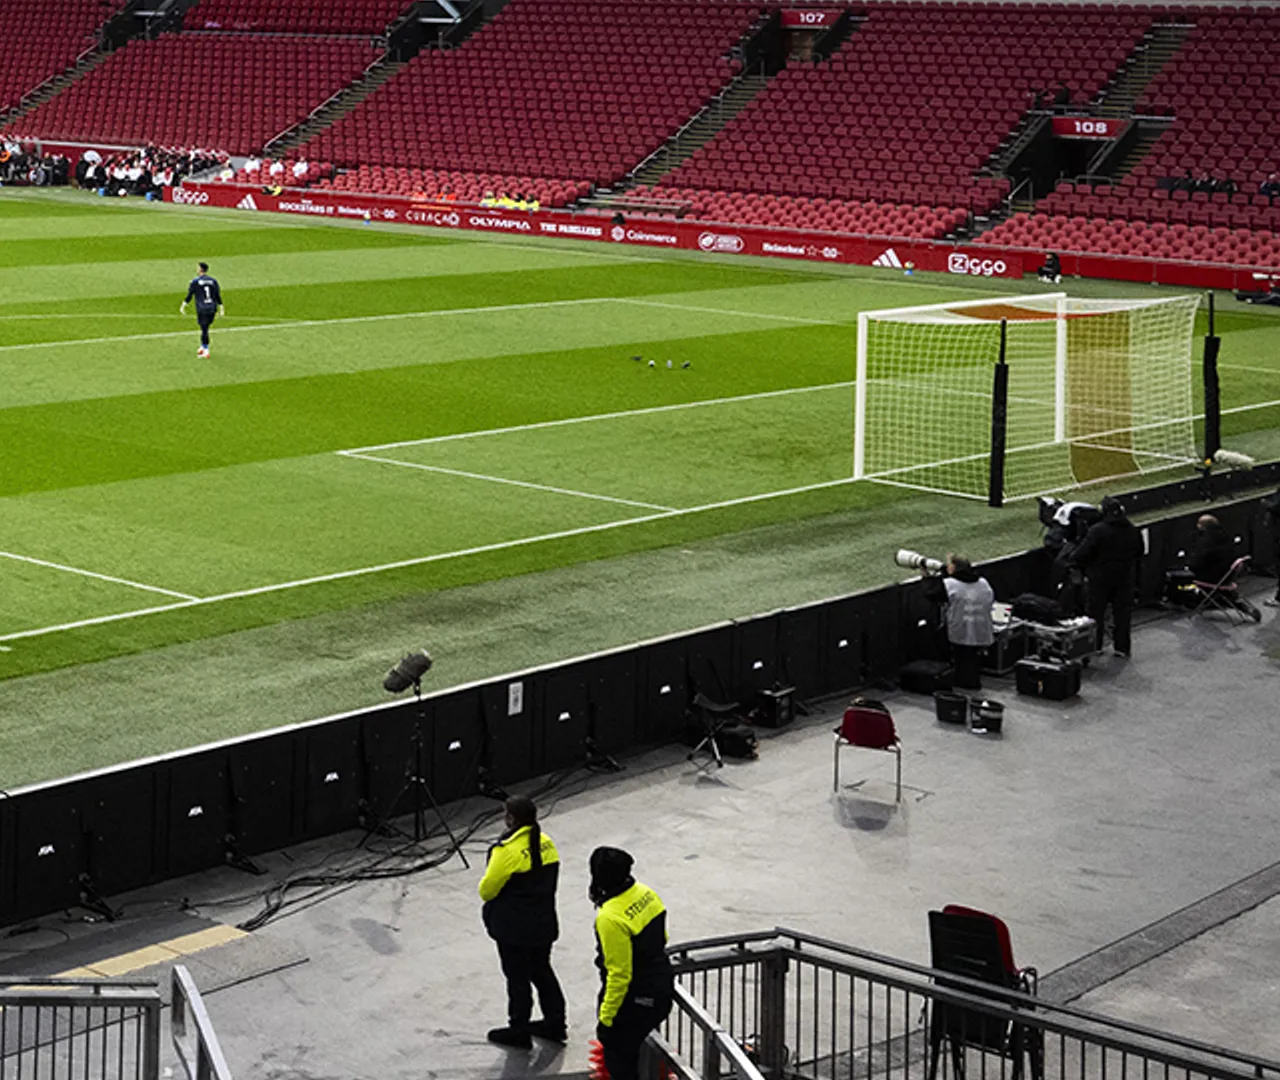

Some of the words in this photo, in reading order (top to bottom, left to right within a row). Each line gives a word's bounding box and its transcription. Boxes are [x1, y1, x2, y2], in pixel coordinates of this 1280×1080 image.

[799, 12, 826, 24] 107
[1073, 121, 1108, 134] 108
[469, 216, 532, 231] OLYMPIA
[204, 286, 214, 303] 1
